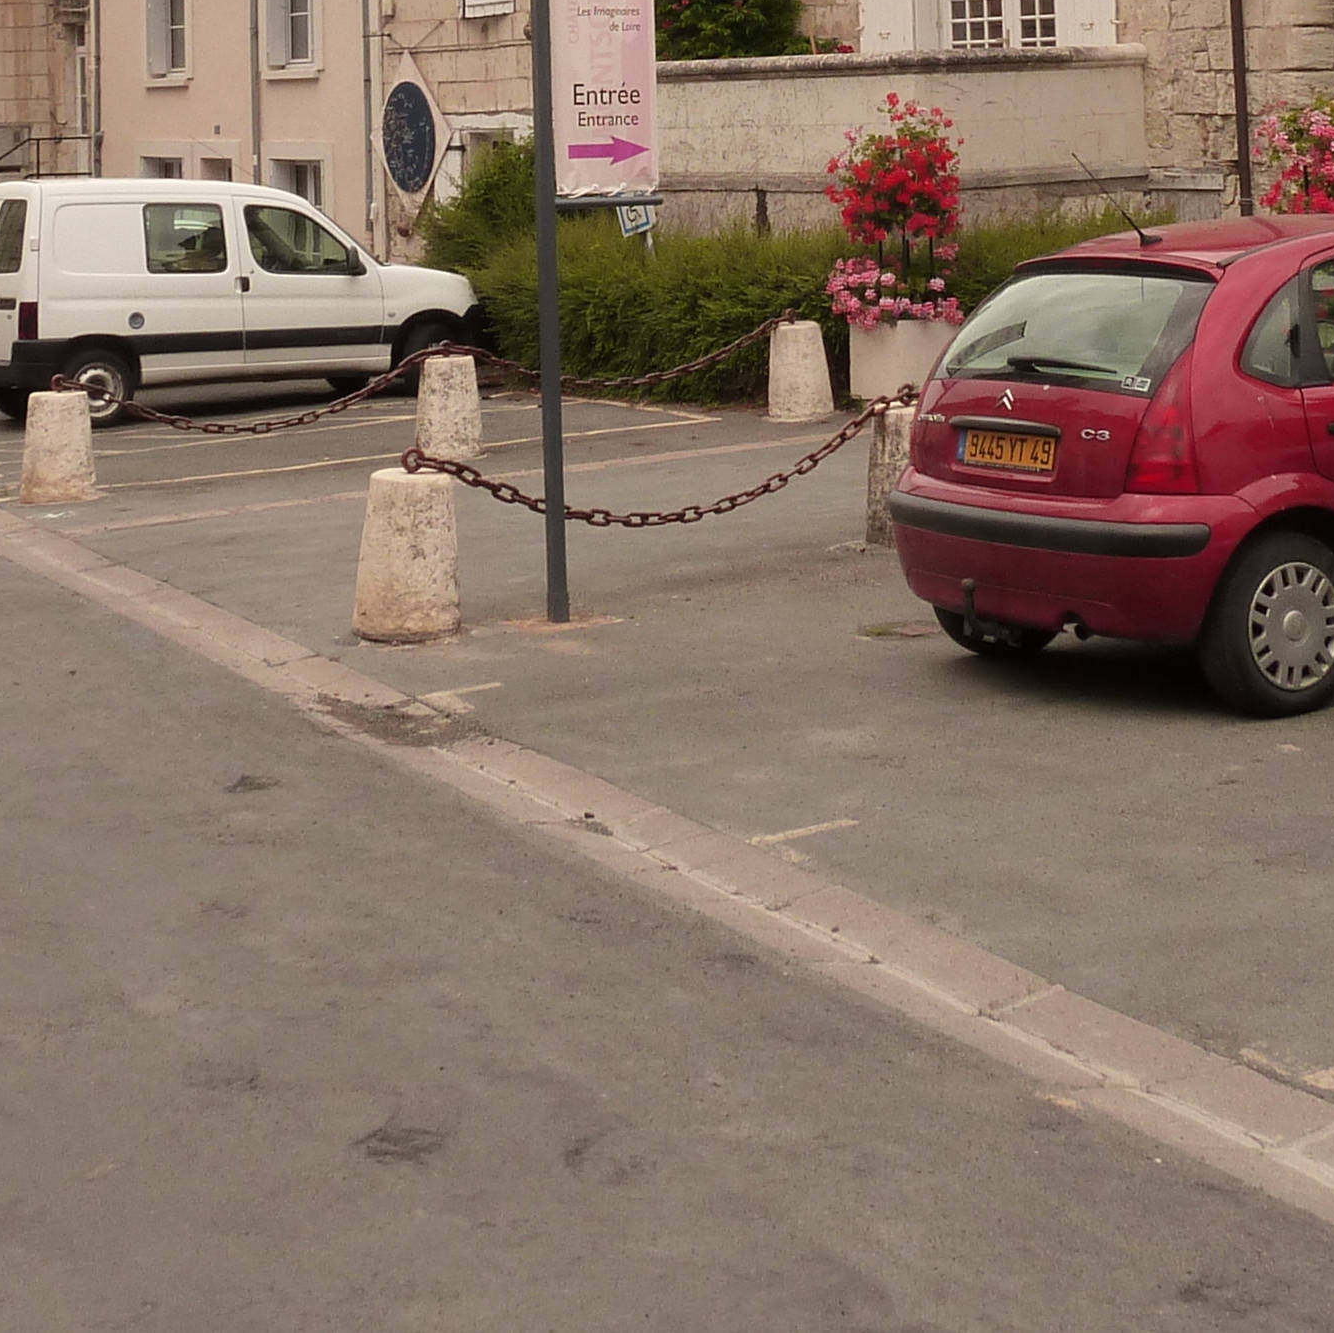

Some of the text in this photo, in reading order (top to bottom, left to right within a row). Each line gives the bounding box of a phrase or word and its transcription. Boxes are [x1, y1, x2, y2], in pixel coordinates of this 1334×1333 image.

[577, 6, 591, 17] Les
[609, 21, 641, 32] de Loire
[573, 81, 641, 106] Entrée
[578, 111, 639, 127] Entrance
[1080, 428, 1111, 441] C3
[969, 433, 1005, 460] 9445
[1009, 437, 1027, 463] YT
[1030, 439, 1052, 465] 49
